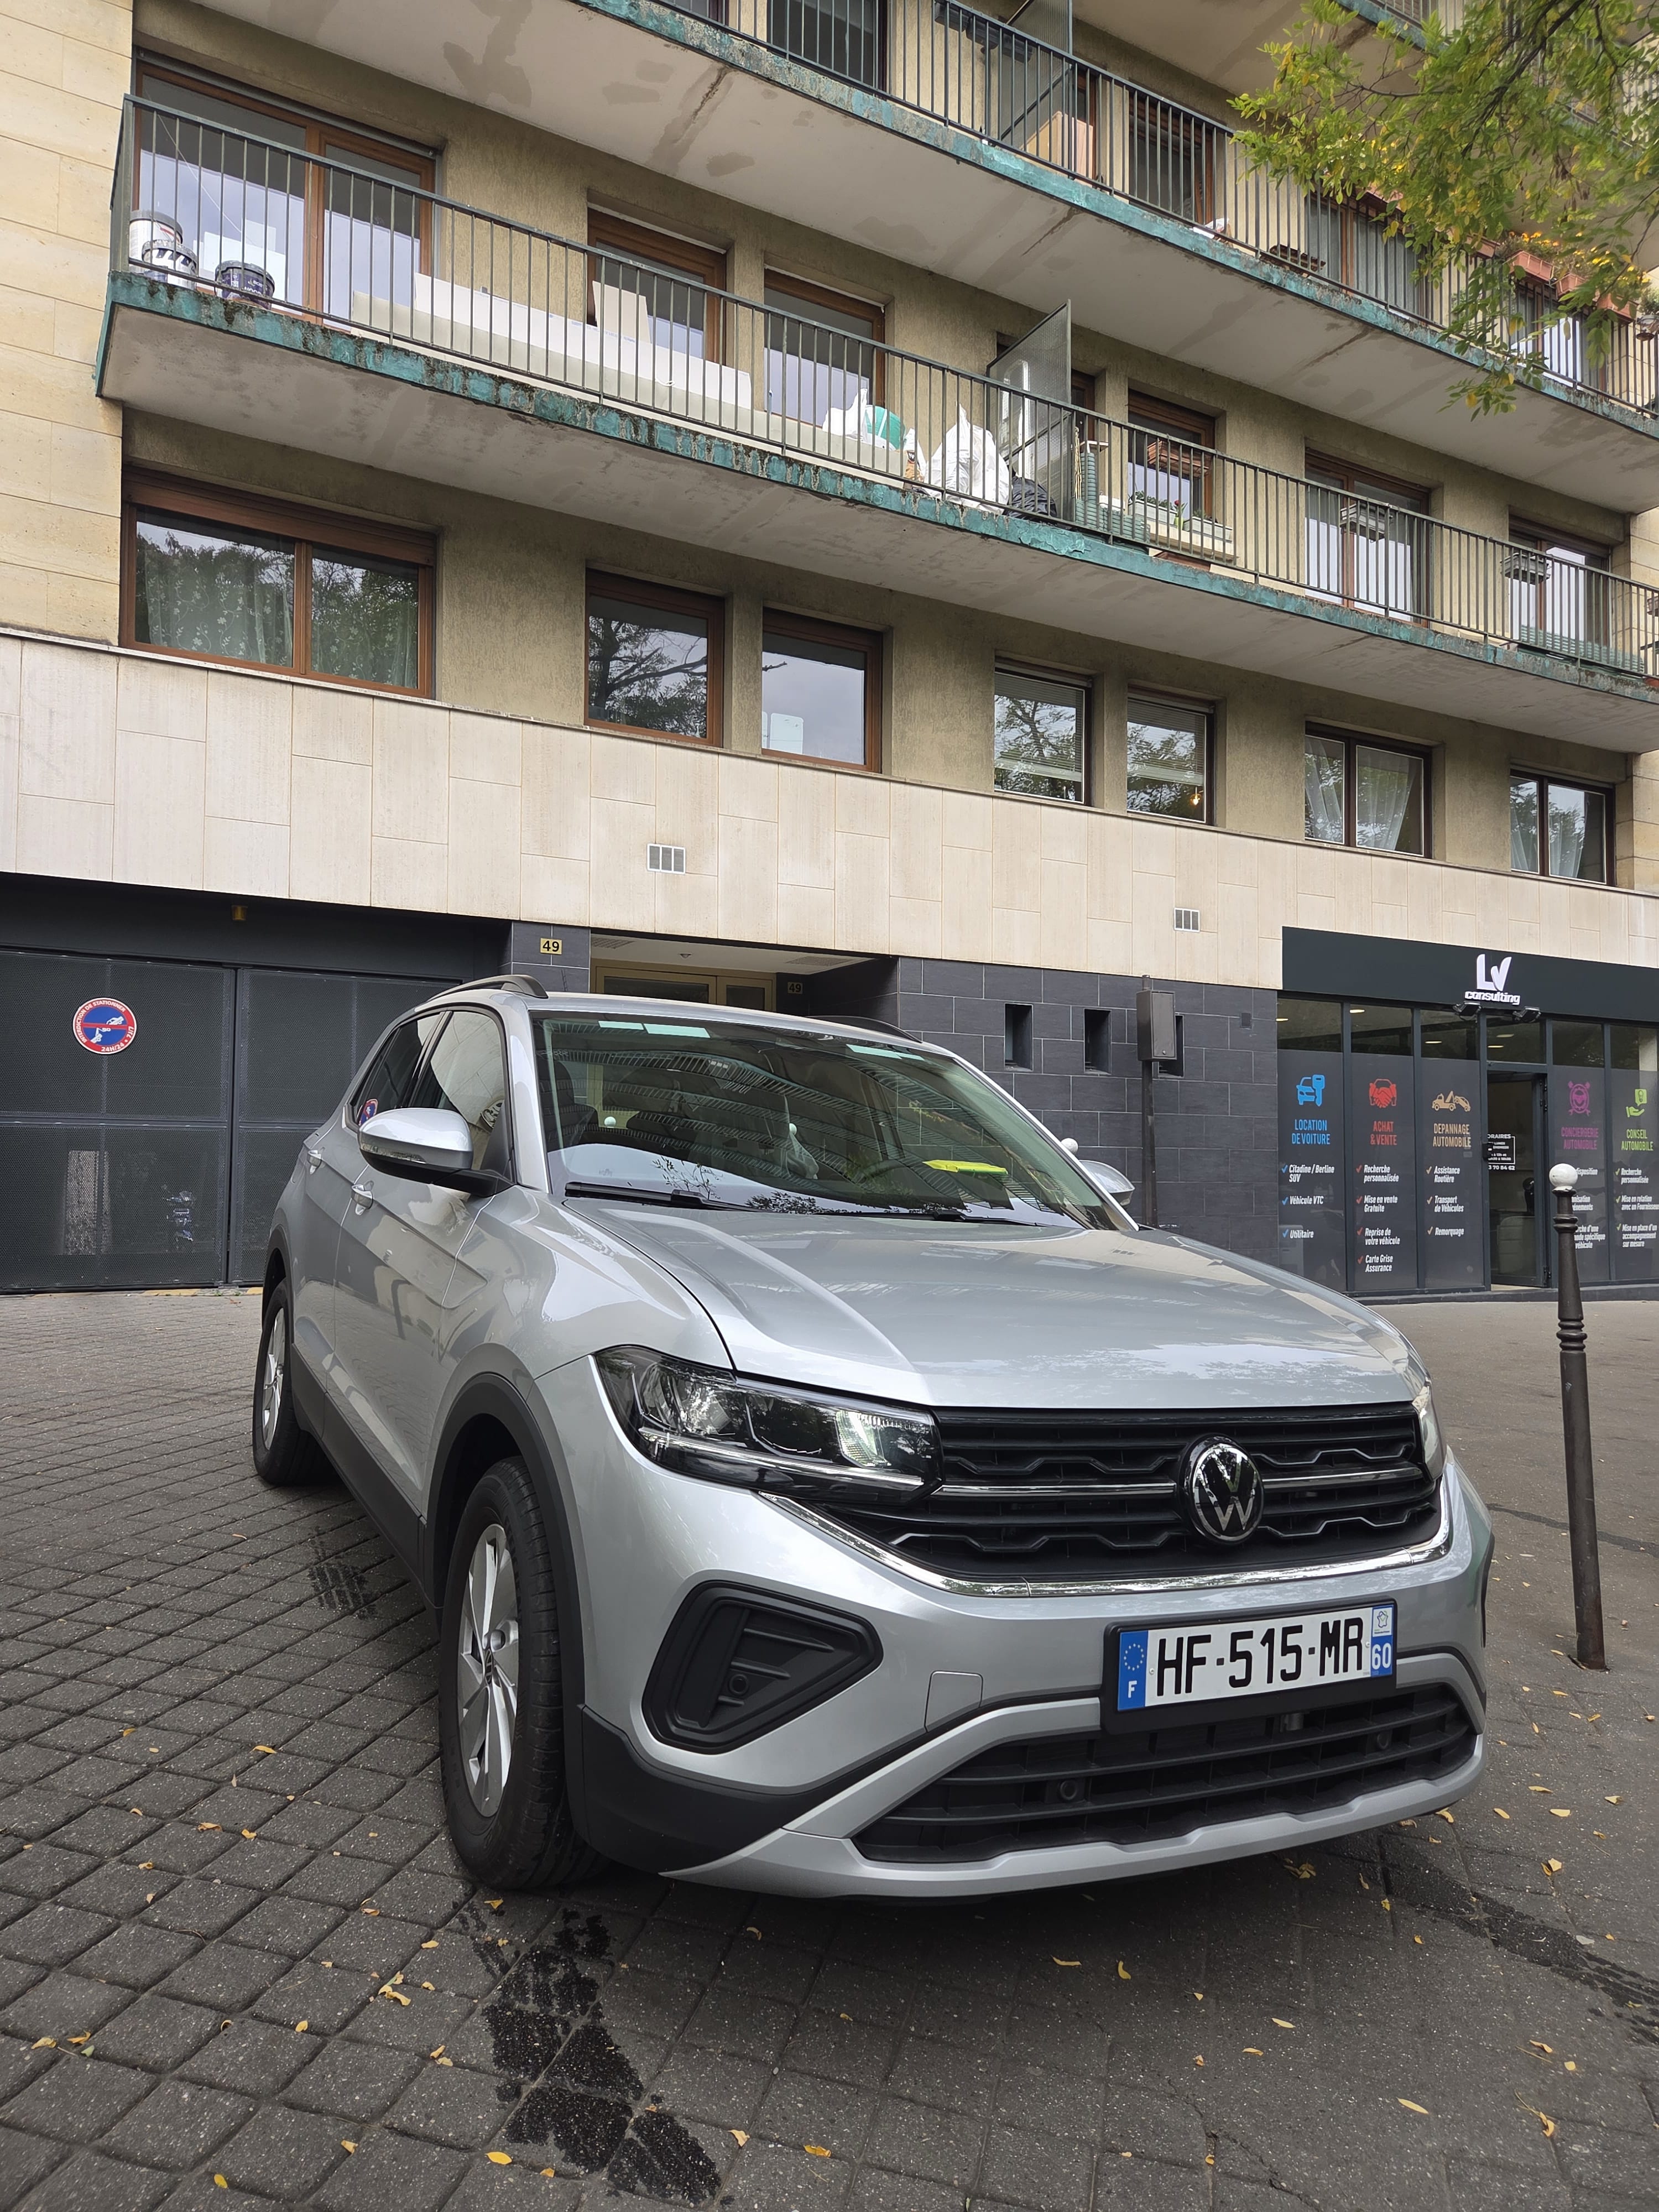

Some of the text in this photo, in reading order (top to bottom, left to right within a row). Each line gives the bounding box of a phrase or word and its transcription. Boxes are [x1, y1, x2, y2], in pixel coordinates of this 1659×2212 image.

[542, 940, 560, 952] 49
[789, 983, 801, 993] 49
[1464, 991, 1520, 1005] consulting
[76, 1009, 87, 1043] INTERDICTION
[93, 1000, 126, 1012] STATIONNER
[101, 1042, 125, 1052] 24H/24
[1295, 1119, 1327, 1131] LOCATION
[1373, 1121, 1394, 1132] ACHAT
[1433, 1123, 1470, 1134] DEPANNAGE
[1561, 1127, 1599, 1138] CONCIERGERIE
[1626, 1129, 1648, 1139] CONSEIL
[1292, 1133, 1331, 1145] DE VOITURE
[1433, 1136, 1472, 1147] AUTOMOBILE
[1563, 1139, 1598, 1150] AUTOMOBILE
[1621, 1141, 1654, 1151] AUTOMOBILE
[1289, 1165, 1311, 1173] Citadine
[1316, 1165, 1334, 1173] Berline
[1364, 1165, 1390, 1173] Recherche
[1434, 1166, 1460, 1175] Assistance
[1289, 1173, 1301, 1182] SUV
[1364, 1173, 1399, 1183] personnalisée
[1434, 1175, 1454, 1183] Routière
[1290, 1196, 1324, 1204] Véhicule VTC
[1364, 1195, 1376, 1203] Mise
[1434, 1196, 1457, 1206] Transport
[1364, 1204, 1385, 1212] Gratuite
[1441, 1204, 1464, 1212] Véhicules
[1290, 1230, 1314, 1238] Utilitaire
[1365, 1228, 1391, 1237] Reprise de
[1435, 1227, 1464, 1237] Remorquage
[1365, 1237, 1400, 1245] votre véhicule
[1365, 1254, 1393, 1263] Carte Grise
[1365, 1264, 1392, 1272] Assurance
[1157, 1617, 1363, 1697] HF-515-MR
[1371, 1642, 1391, 1670] 60
[1128, 1680, 1138, 1698] F
